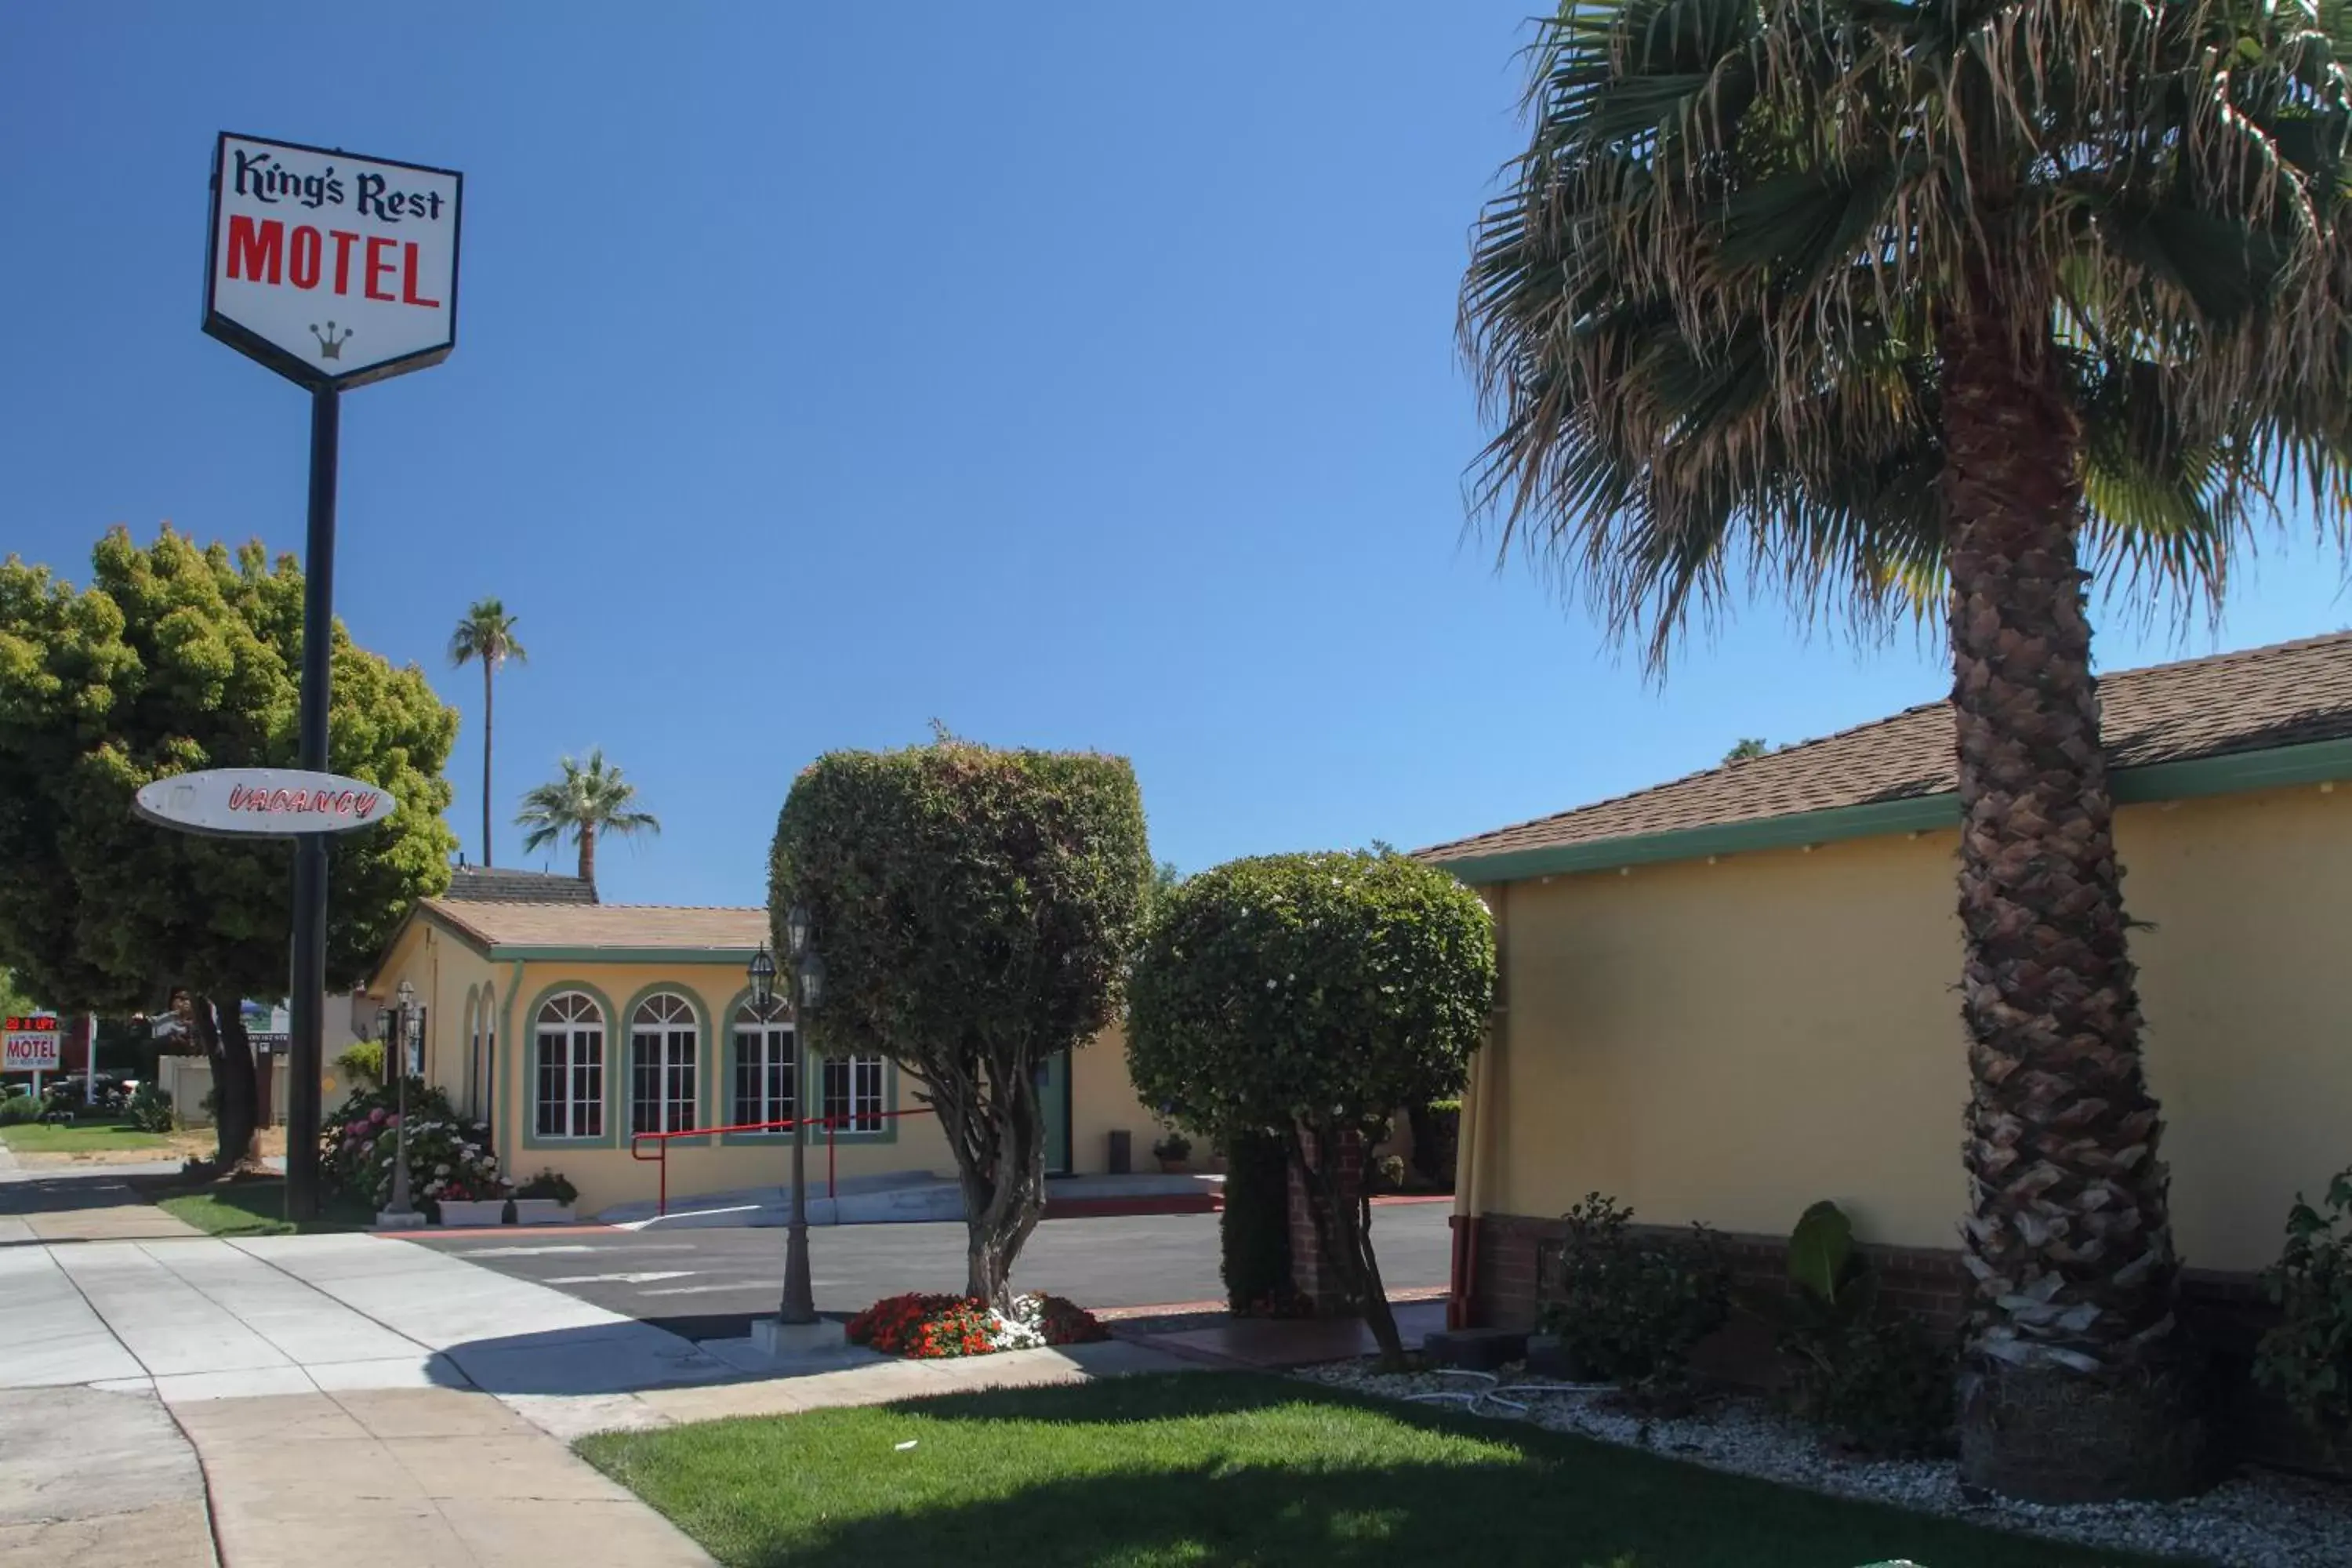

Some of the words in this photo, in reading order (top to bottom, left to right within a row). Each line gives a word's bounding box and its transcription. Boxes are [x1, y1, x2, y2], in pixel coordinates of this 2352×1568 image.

[234, 149, 344, 209] King's
[357, 172, 445, 223] Rest
[226, 214, 440, 308] MOTEL
[230, 786, 379, 818] VACANCY
[6, 1040, 56, 1058] MOTEL
